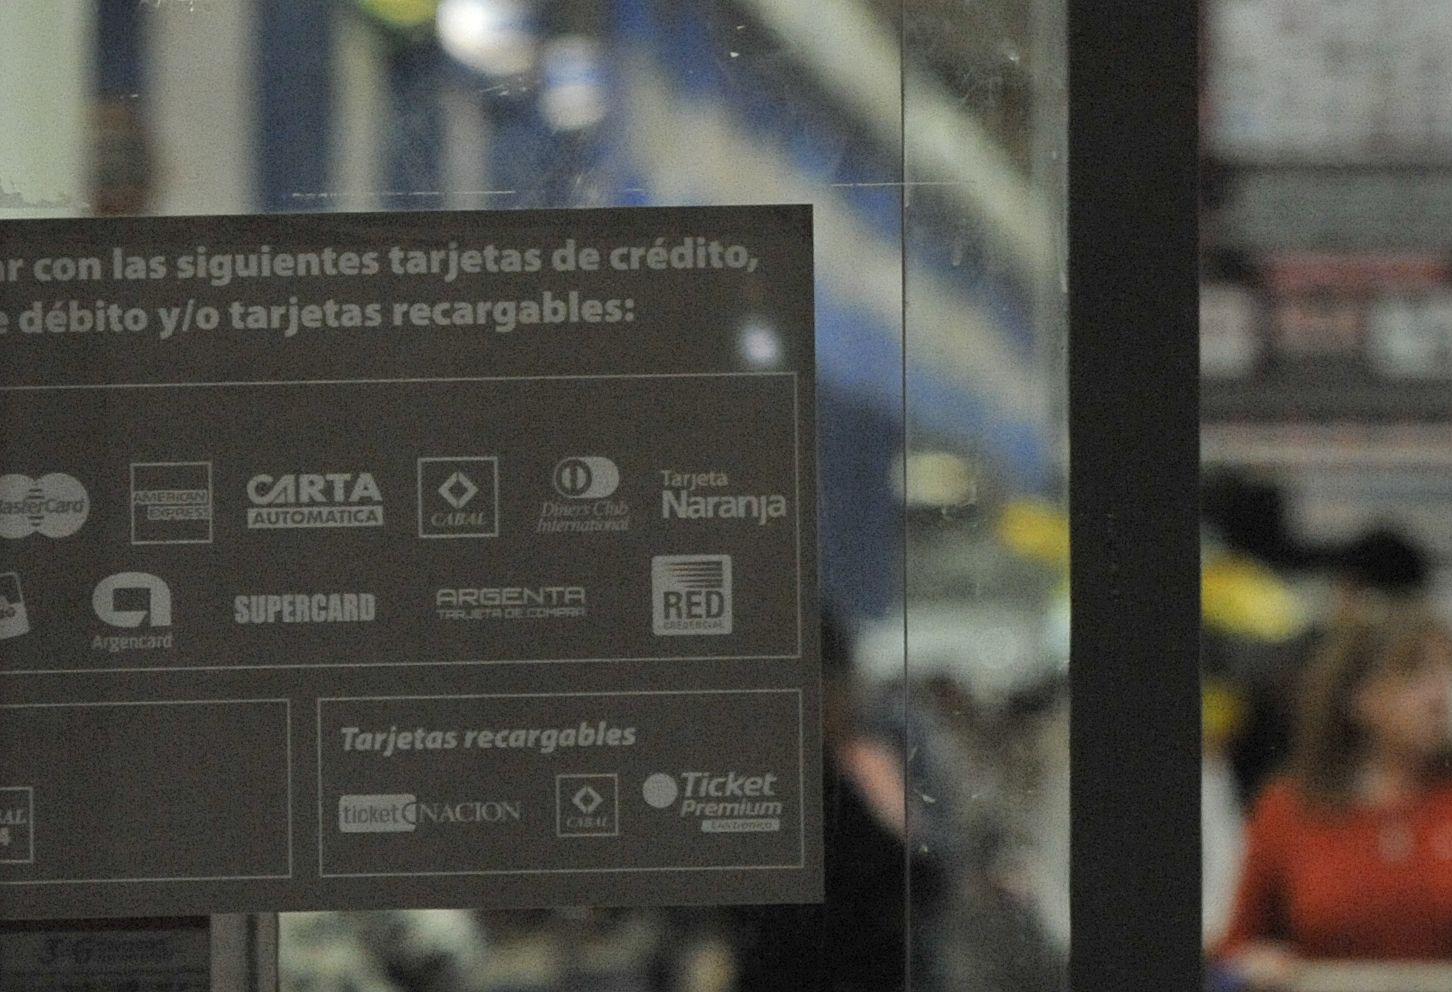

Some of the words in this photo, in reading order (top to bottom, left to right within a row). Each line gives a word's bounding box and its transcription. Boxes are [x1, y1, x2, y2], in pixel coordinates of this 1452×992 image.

[33, 256, 101, 281] con
[113, 247, 167, 279] las
[177, 244, 379, 287] siguientes
[389, 241, 541, 285] tarjetas
[551, 239, 601, 275] de
[608, 237, 759, 274] crédito,
[19, 299, 148, 333] débito
[159, 298, 222, 339] y/o
[230, 297, 382, 342] tarjetas
[392, 290, 635, 332] recargables:
[247, 472, 384, 504] CARTA
[661, 469, 728, 490] Tarjeta
[0, 498, 84, 514] asterCard
[253, 509, 379, 526] AUTOMATICA
[661, 491, 787, 526] Naranja
[431, 512, 486, 527] CABAL
[436, 586, 585, 606] ARGENTA
[663, 590, 724, 619] RED
[234, 593, 376, 624] SUPERCARD
[93, 632, 173, 652] Argencard
[341, 726, 457, 757] Tarjetas
[464, 721, 637, 754] recargables
[681, 771, 778, 797] Ticket
[343, 803, 398, 824] ticket
[680, 799, 782, 818] Premium
